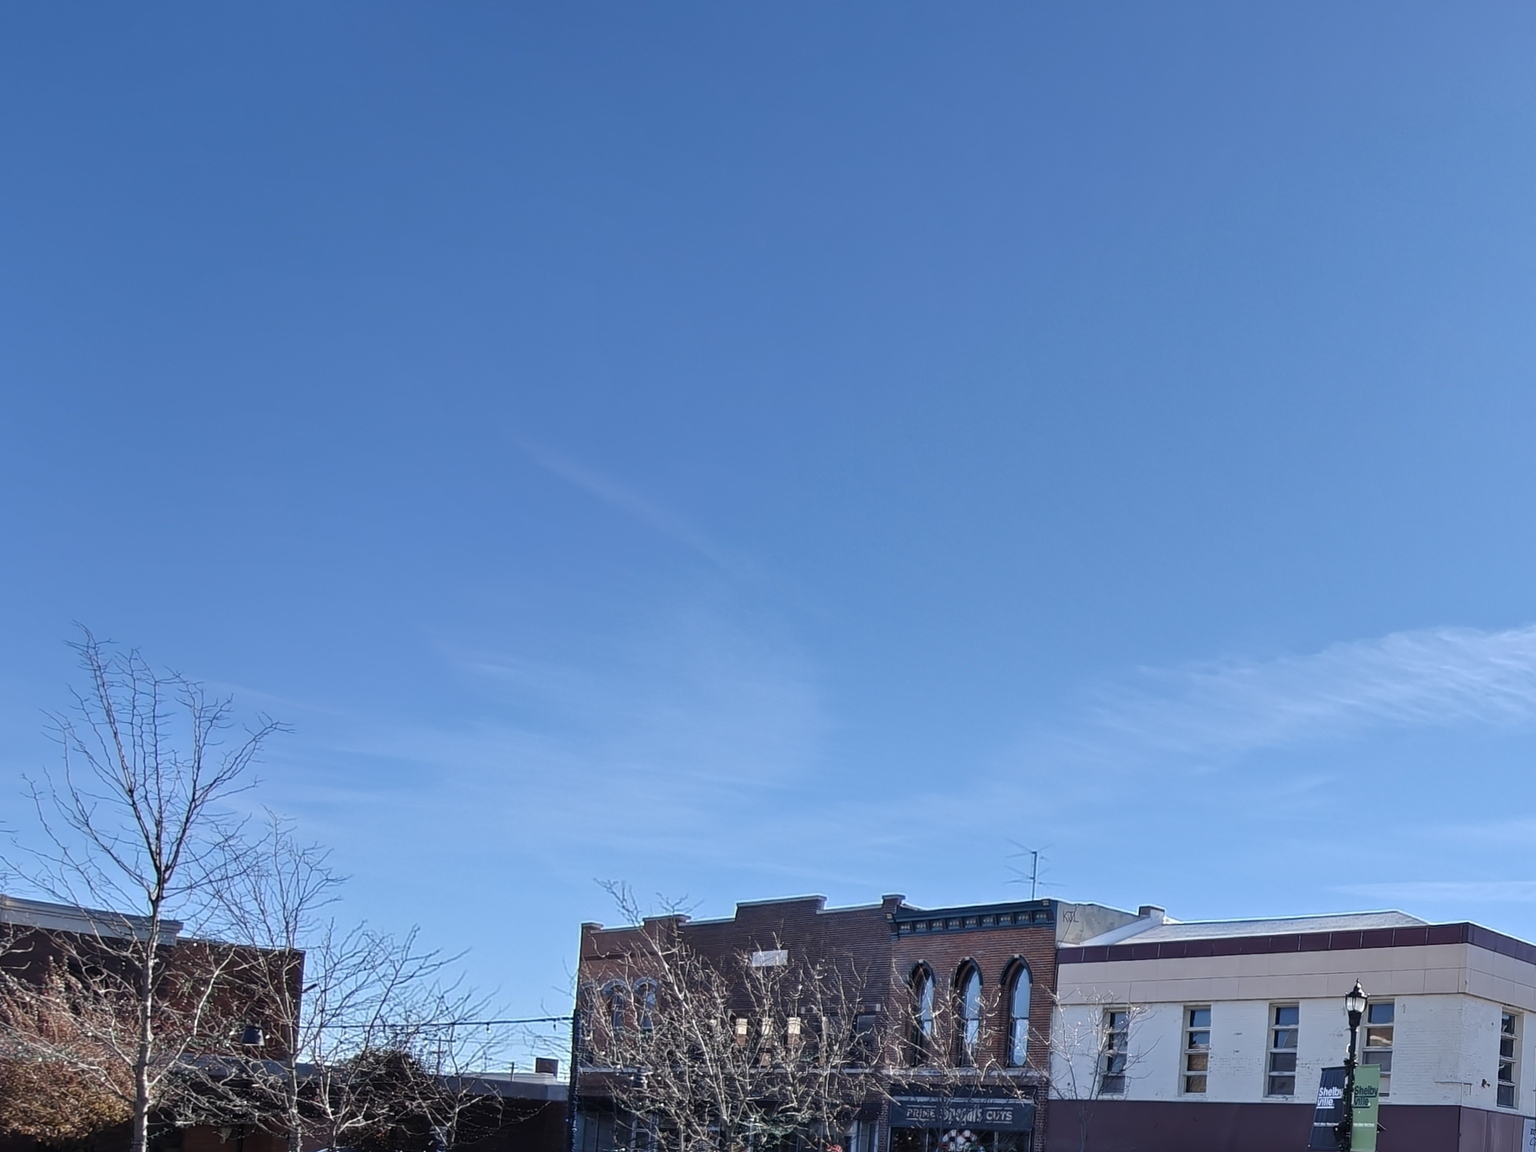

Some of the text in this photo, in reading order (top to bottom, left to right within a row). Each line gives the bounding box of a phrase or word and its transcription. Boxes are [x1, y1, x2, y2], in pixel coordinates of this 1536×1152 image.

[1318, 1086, 1344, 1098] Shelby
[1354, 1085, 1379, 1097] Shelby
[986, 1111, 1013, 1121] CUTS
